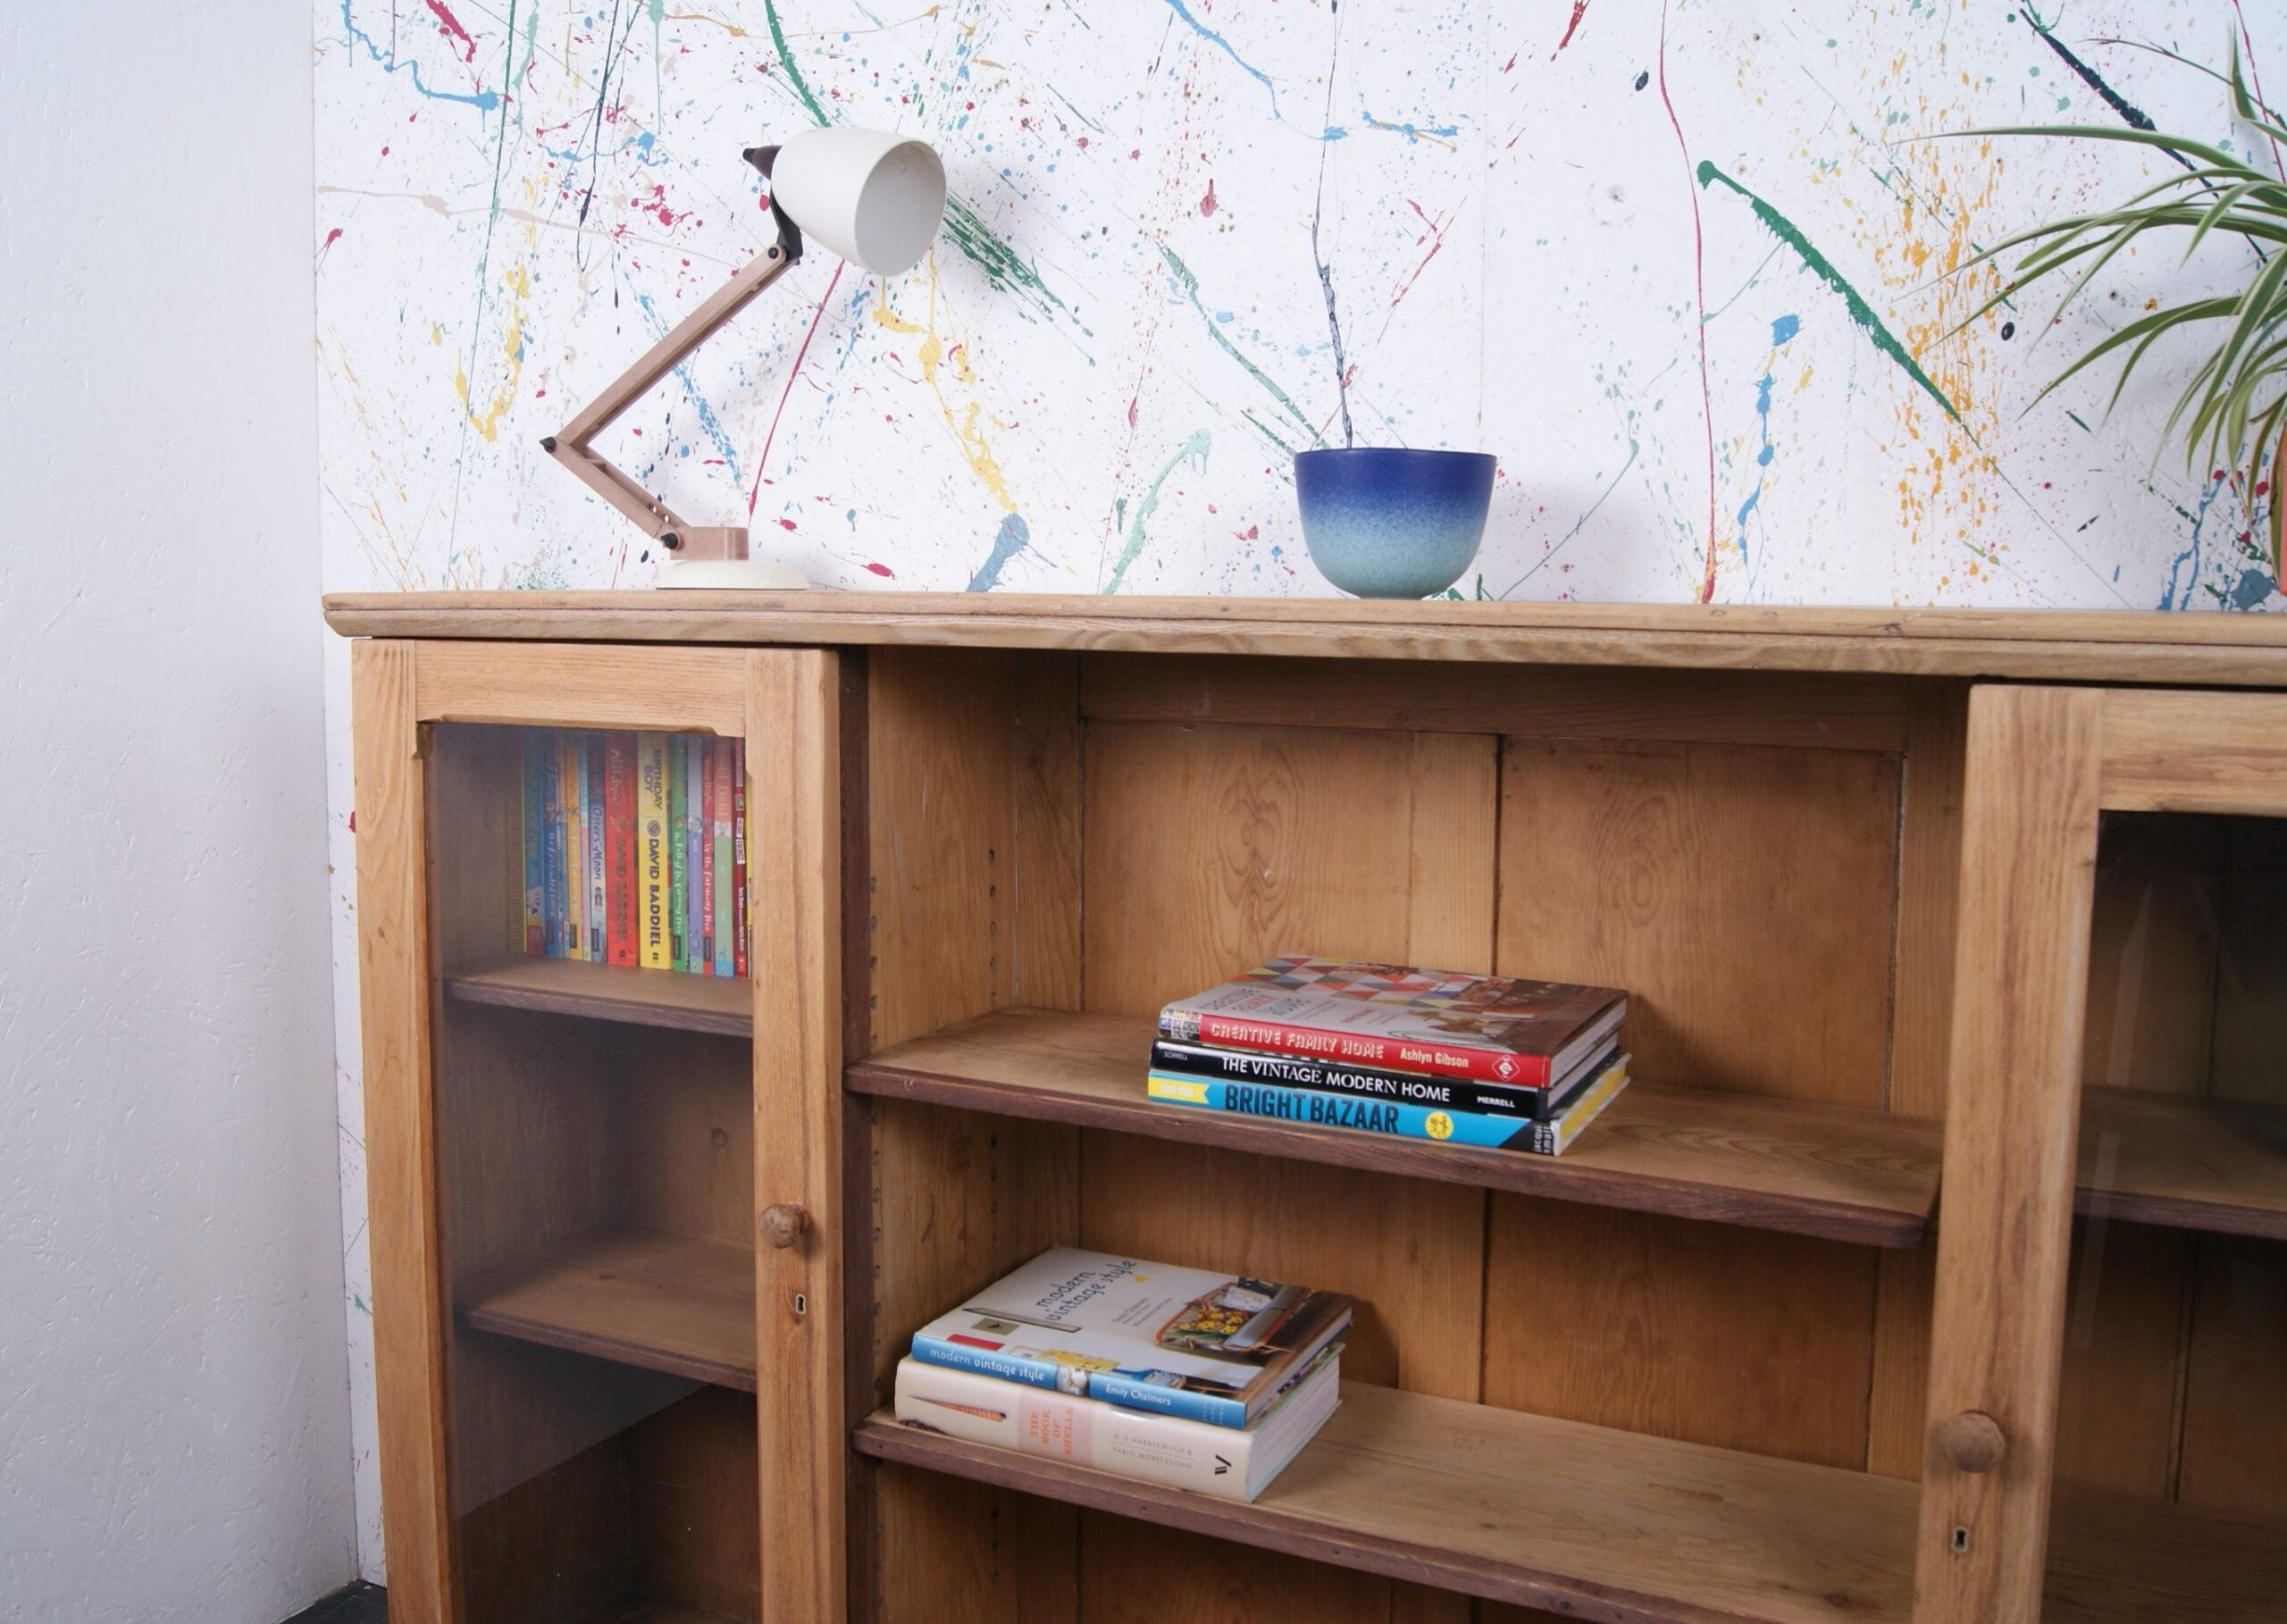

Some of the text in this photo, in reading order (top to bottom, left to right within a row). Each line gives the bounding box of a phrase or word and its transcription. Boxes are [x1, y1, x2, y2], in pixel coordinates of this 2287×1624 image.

[643, 765, 653, 794] BOY
[653, 749, 663, 810] BIRTHDAY
[717, 786, 732, 816] Dahl
[592, 846, 603, 880] Moon
[649, 838, 661, 948] DAVID BADDIEL
[703, 871, 713, 912] Faraway
[1164, 1051, 1189, 1062] SORRELL
[1210, 1022, 1384, 1059] CREATIVE FAMILY HOME
[1400, 1048, 1470, 1068] Ashlyn Gibson
[1222, 1057, 1451, 1102] THE VINTAGE MODERN HOME
[1225, 1084, 1307, 1122] BRIGHT
[1310, 1094, 1400, 1134] BAZAAR
[1477, 1095, 1516, 1109] MERRELL
[1533, 1126, 1543, 1153] jacqui
[1543, 1126, 1554, 1154] small
[1035, 1270, 1096, 1309] modern
[1045, 1283, 1106, 1322] vintage
[1098, 1260, 1137, 1284] style
[930, 1348, 1044, 1382] modern vintage style
[1105, 1384, 1171, 1407] Emily Chalmers
[1030, 1411, 1039, 1439] THE
[1041, 1409, 1051, 1444] BOOK
[1052, 1420, 1060, 1438] OF
[1063, 1406, 1074, 1458] SHELLS
[1112, 1446, 1135, 1458] FABIO
